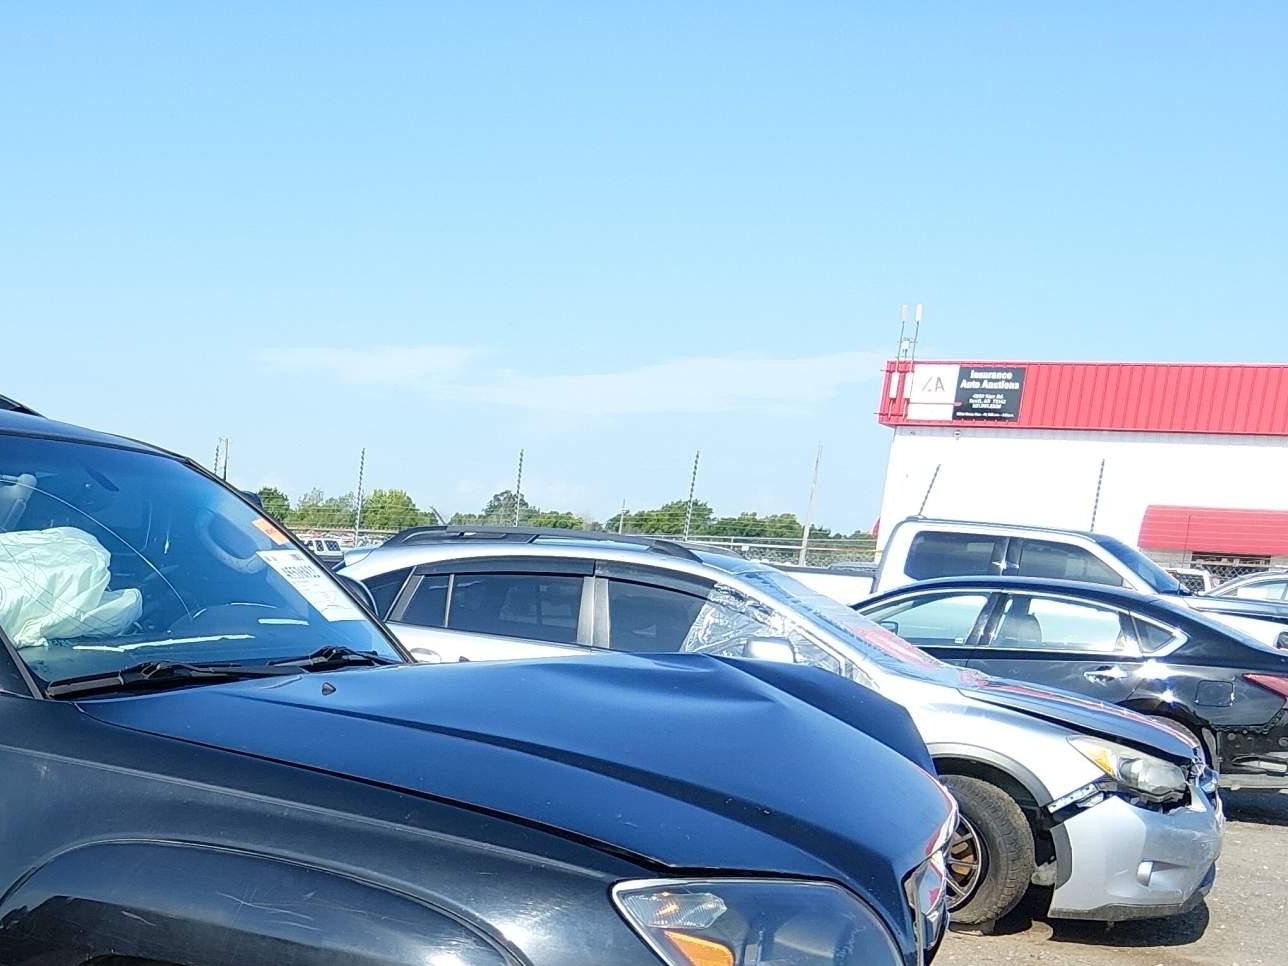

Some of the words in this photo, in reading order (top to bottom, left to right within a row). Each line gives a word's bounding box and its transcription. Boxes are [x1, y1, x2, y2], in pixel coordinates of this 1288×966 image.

[970, 369, 1013, 380] Insurance
[960, 379, 981, 389] Auto
[982, 379, 1020, 390] Auctions
